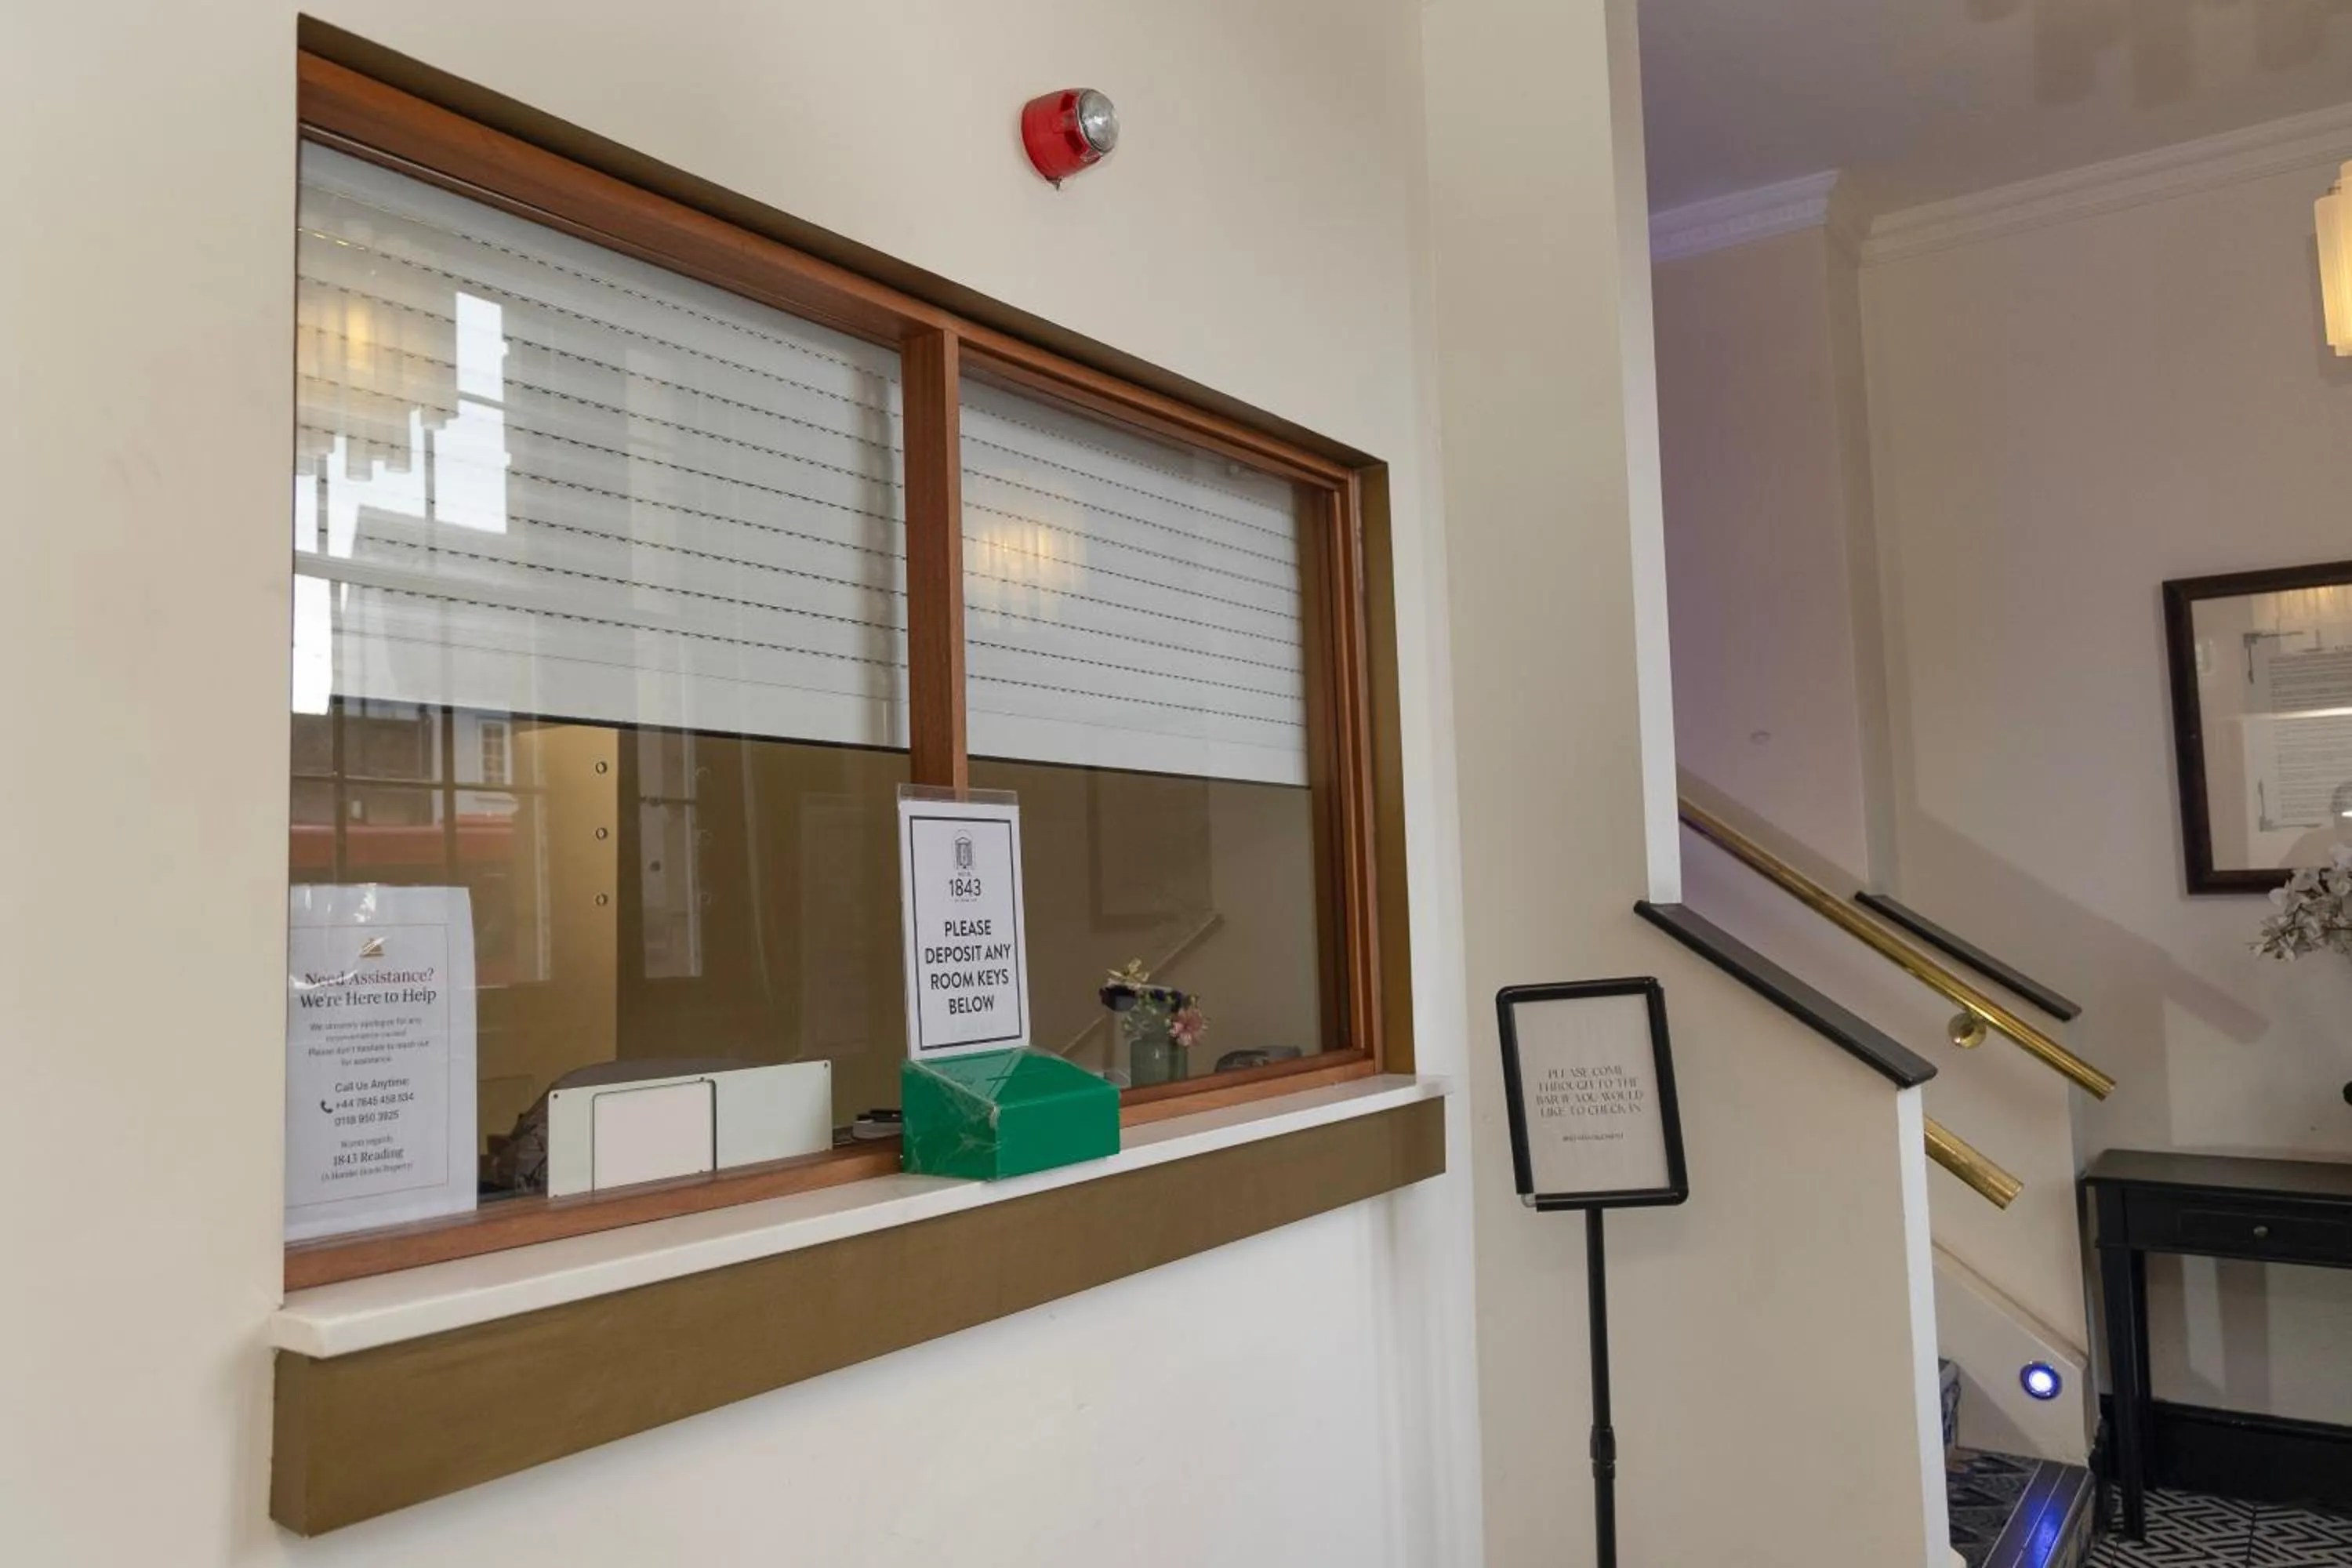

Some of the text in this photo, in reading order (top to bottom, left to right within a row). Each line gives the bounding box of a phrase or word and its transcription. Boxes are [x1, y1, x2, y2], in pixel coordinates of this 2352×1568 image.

[949, 877, 982, 897] 1843
[944, 920, 992, 937] PLEASE
[925, 944, 1011, 964] DEPOSIT ANY
[305, 967, 434, 988] Need Assistance?
[930, 969, 1009, 989] ROOM KEYS
[300, 988, 437, 1008] We're Here to Help
[948, 996, 995, 1014] BELOW
[1548, 1067, 1587, 1080] PLEASE
[335, 1081, 354, 1093] Call
[355, 1080, 369, 1091] Us
[360, 1148, 405, 1163] Reading
